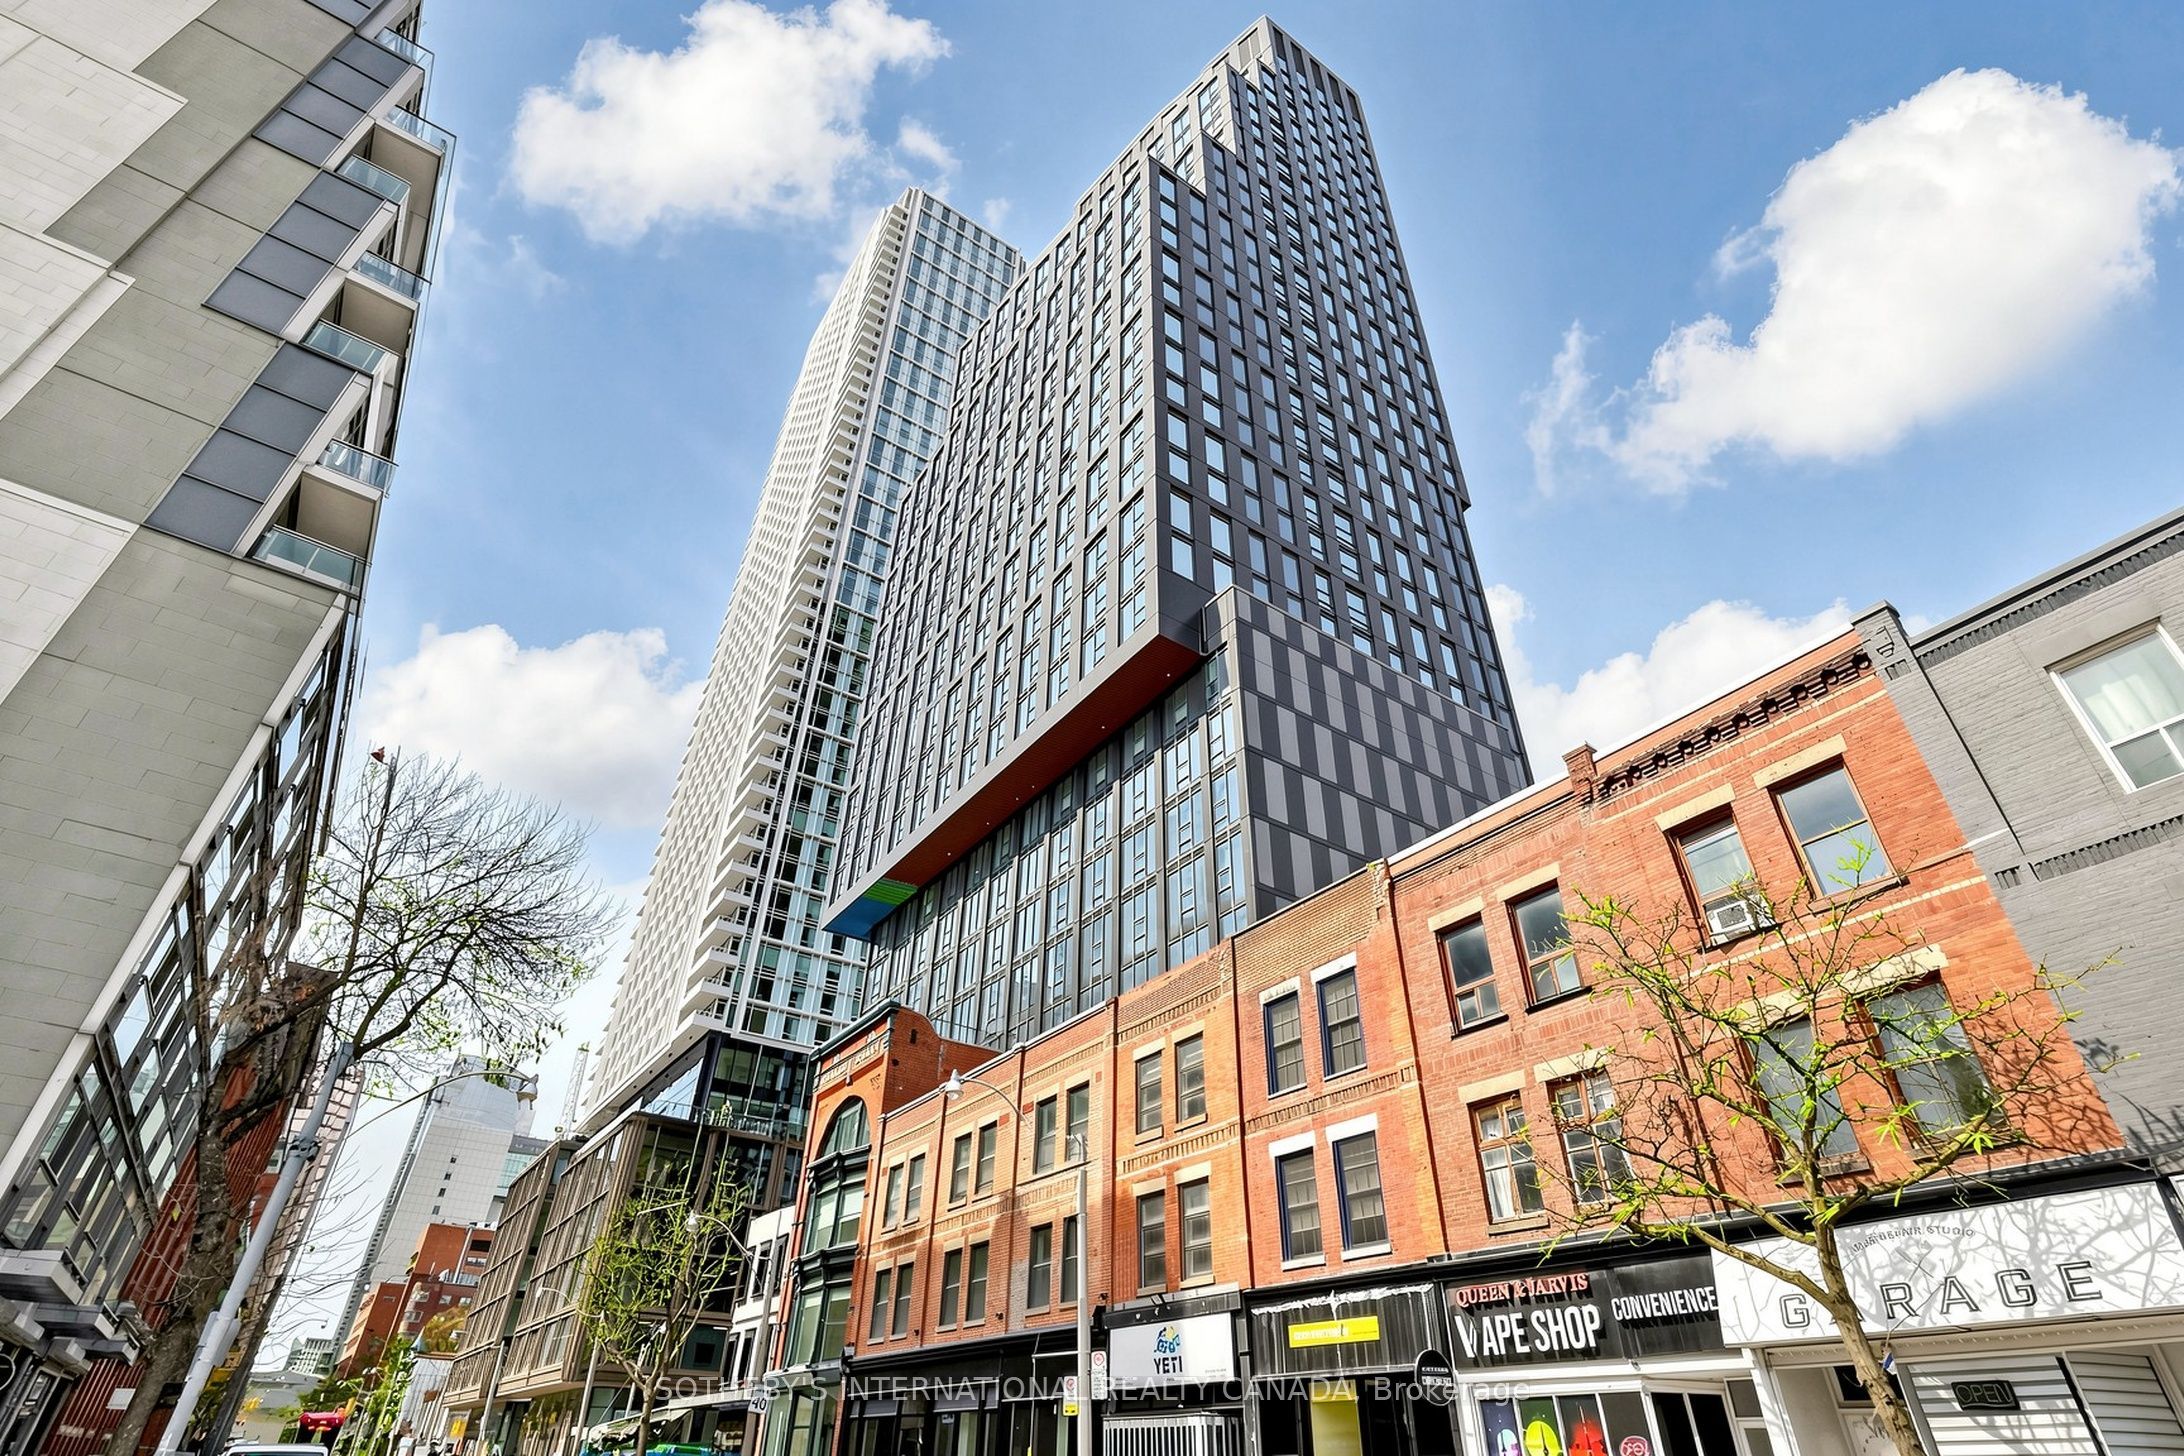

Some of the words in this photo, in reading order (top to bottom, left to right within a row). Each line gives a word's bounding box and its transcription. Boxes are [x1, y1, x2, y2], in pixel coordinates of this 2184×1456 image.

[1456, 1283, 1510, 1307] QUEEN
[1514, 1280, 1527, 1298] &
[1525, 1273, 1588, 1297] JARVIS
[1611, 1286, 1719, 1321] CONVENIENCE
[1779, 1260, 2103, 1329] GRAGE
[1454, 1312, 1531, 1358] VAPE
[1530, 1303, 1600, 1352] SHOP
[1153, 1355, 1183, 1375] YETI
[751, 1397, 767, 1411] 40
[1955, 1384, 2013, 1403] OPEN
